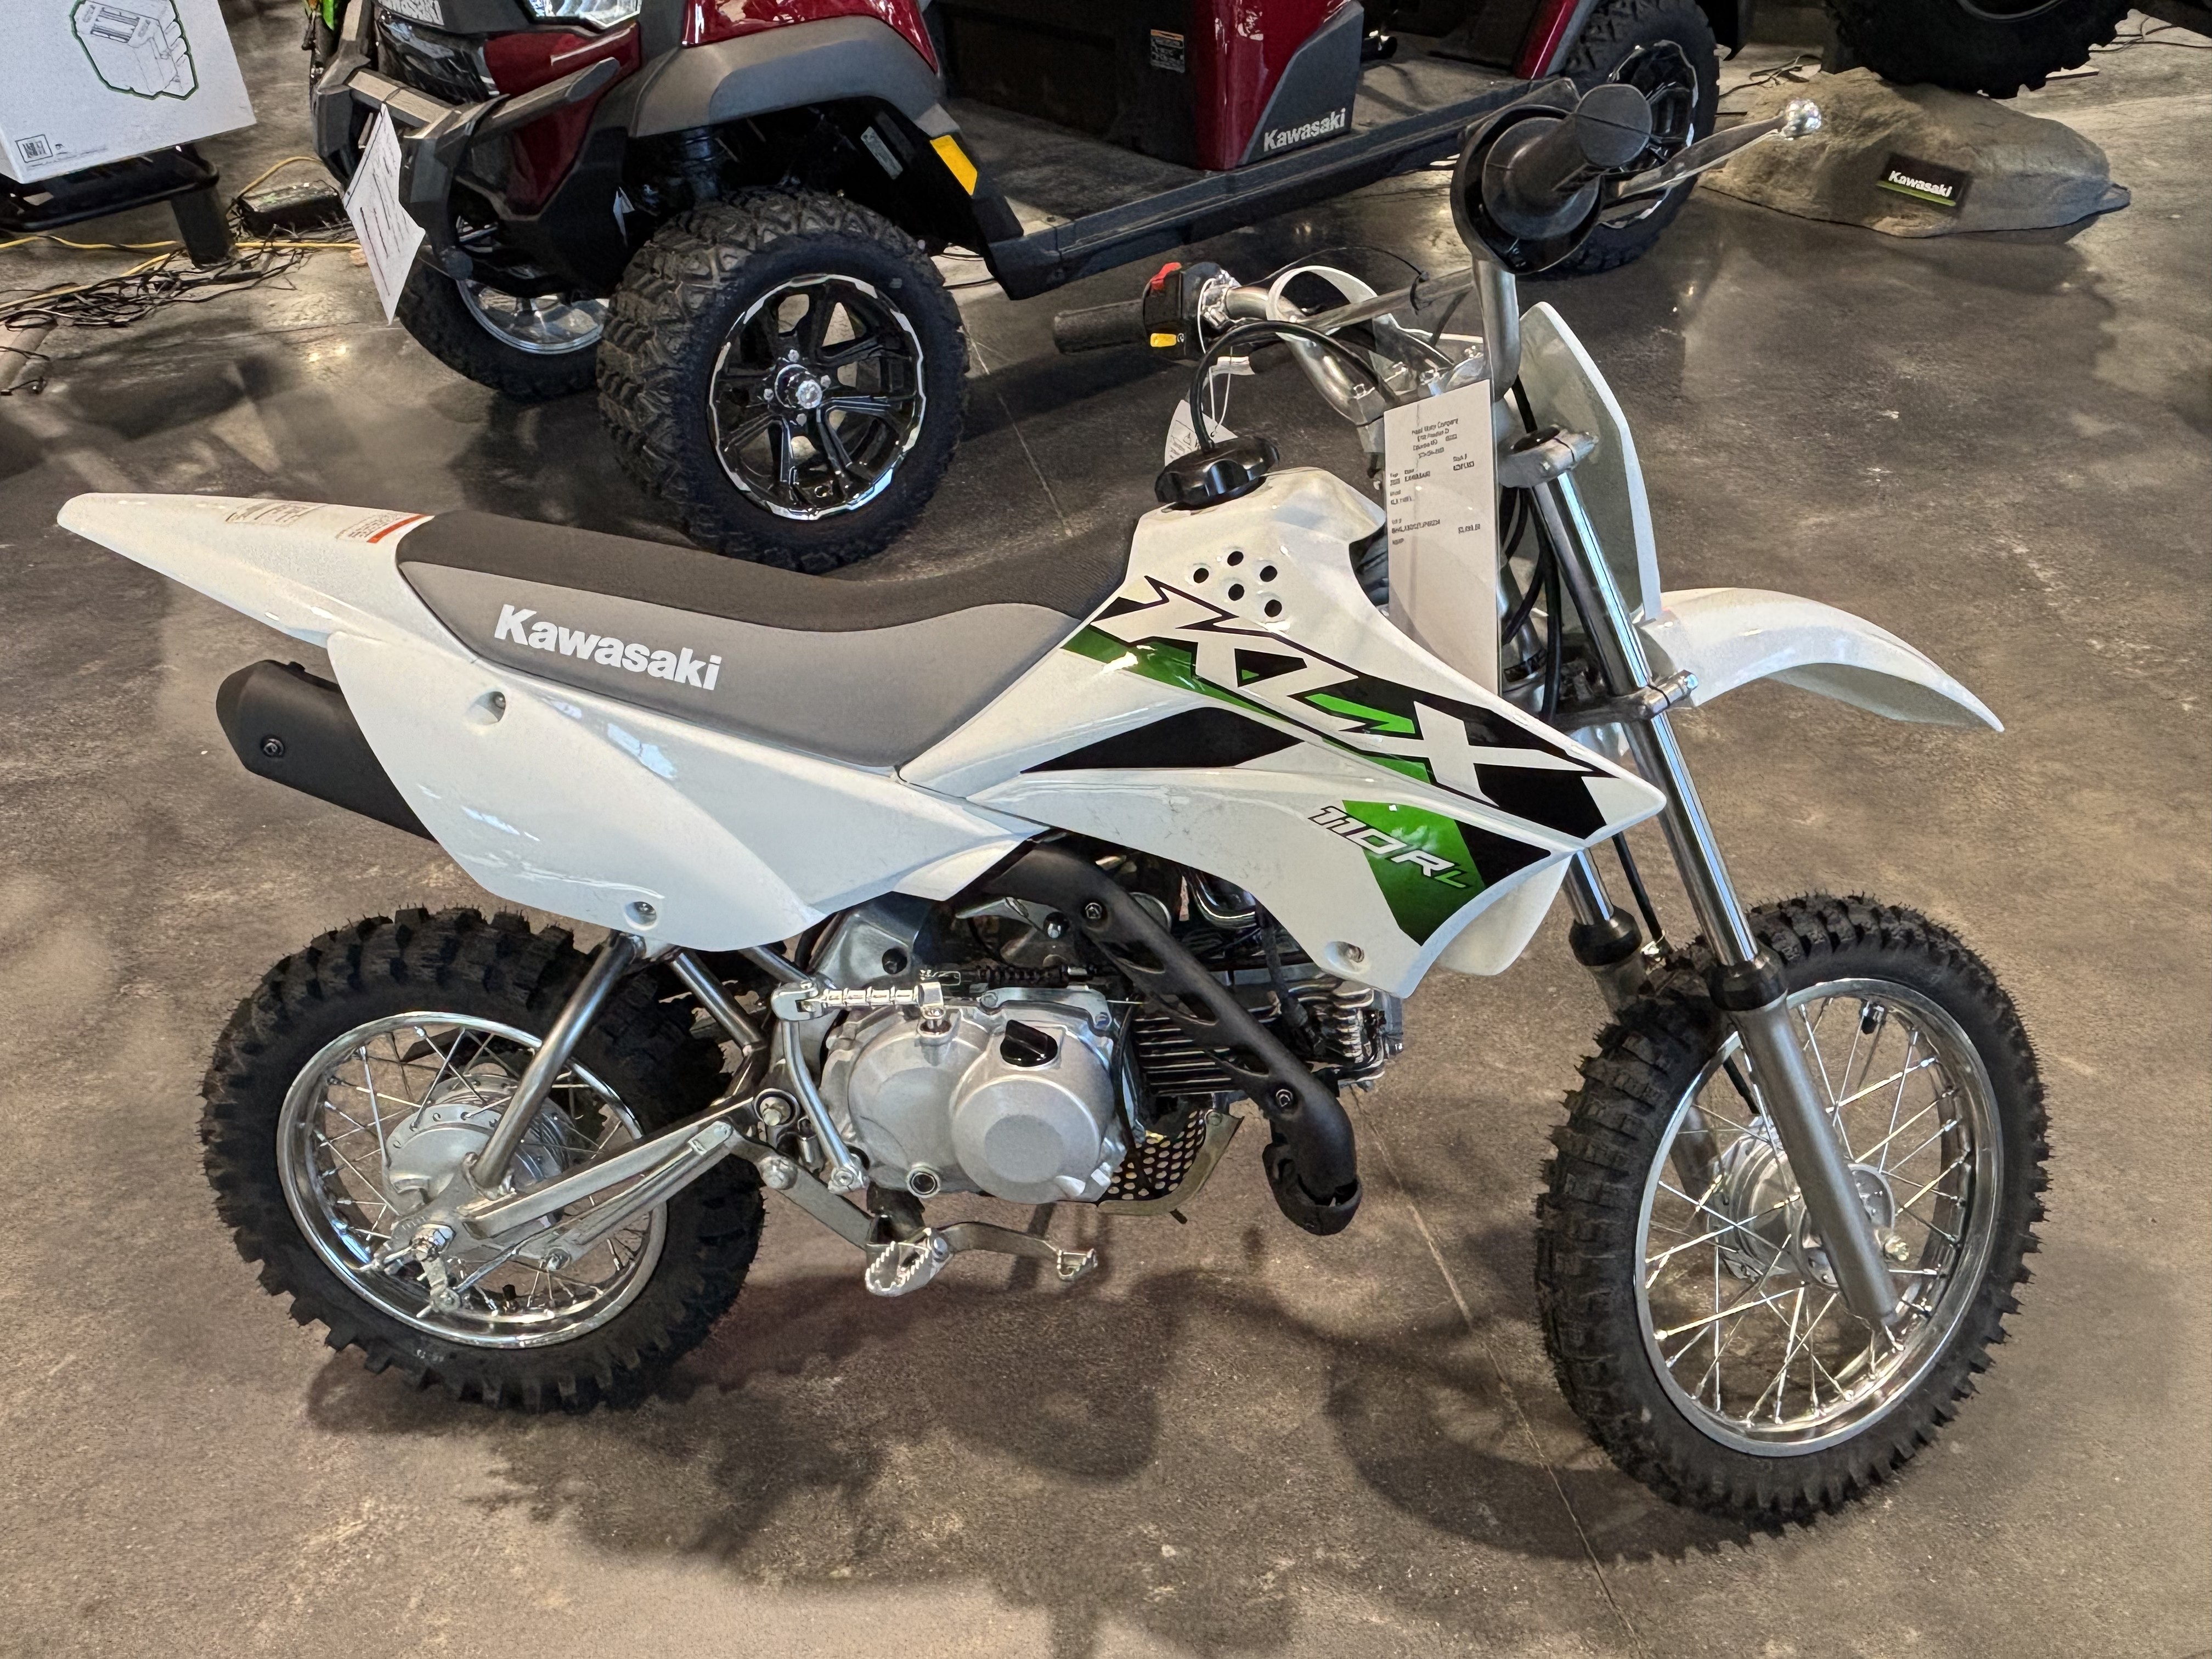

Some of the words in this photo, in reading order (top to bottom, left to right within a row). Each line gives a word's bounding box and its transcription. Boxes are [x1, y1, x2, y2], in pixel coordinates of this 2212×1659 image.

[1263, 108, 1346, 152] Kawasaki
[1888, 170, 1953, 198] Kawasaki
[494, 604, 723, 691] Kawasaki
